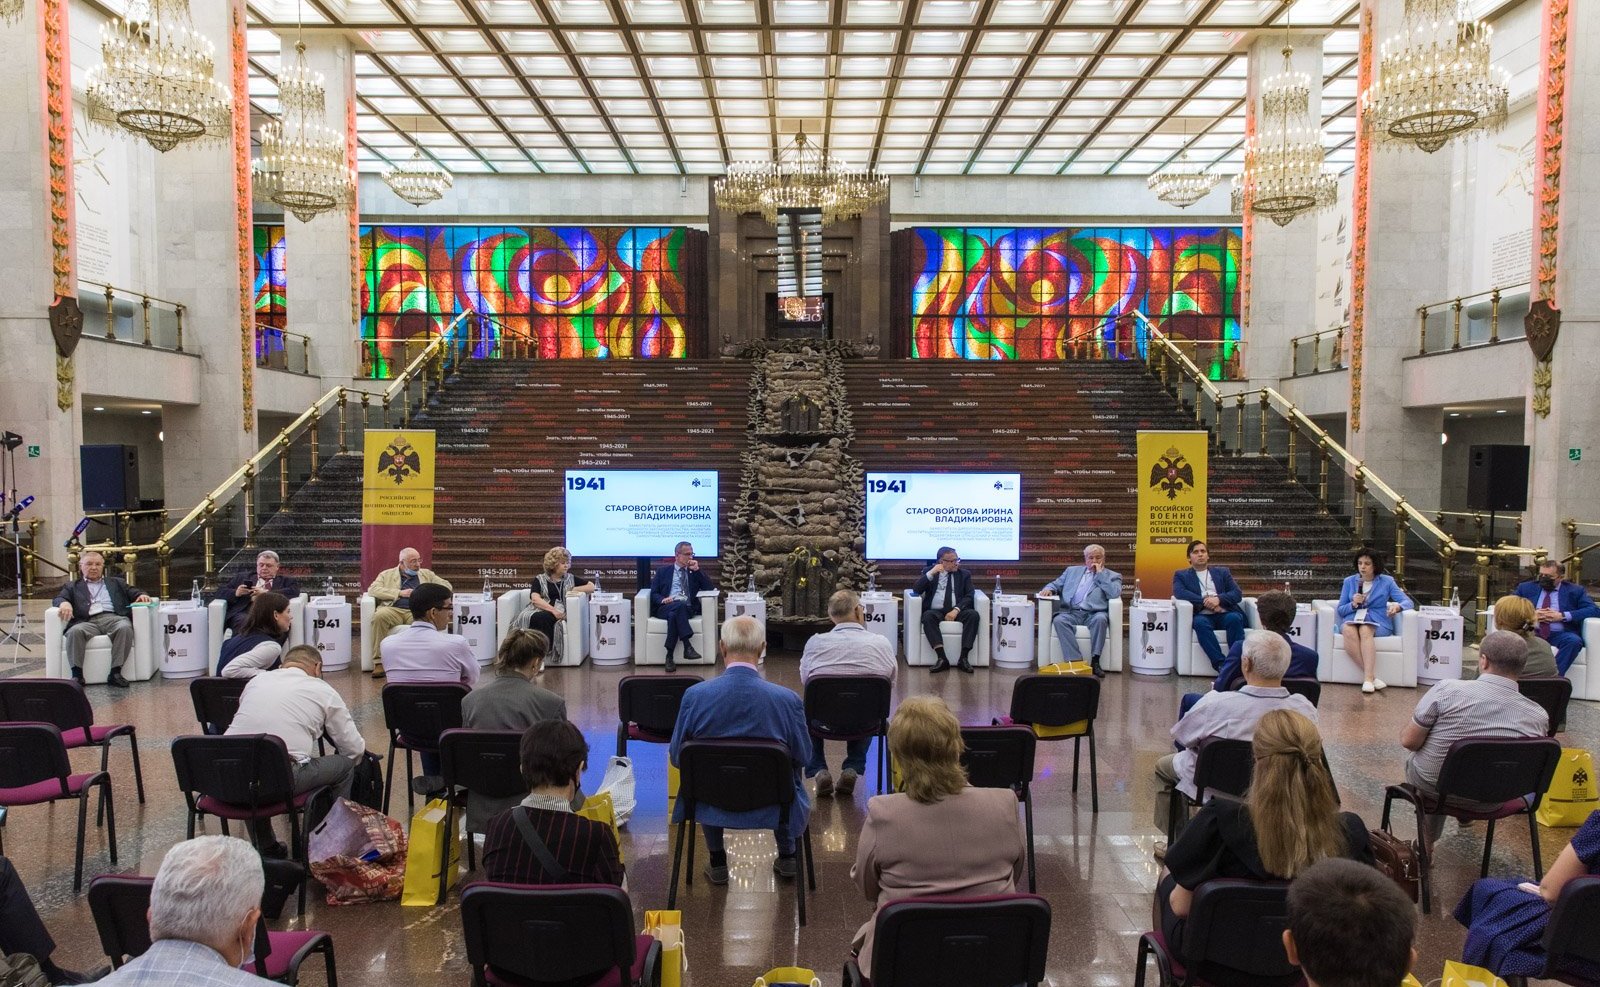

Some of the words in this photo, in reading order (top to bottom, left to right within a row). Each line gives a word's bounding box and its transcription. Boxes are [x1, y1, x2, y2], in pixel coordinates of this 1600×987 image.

[567, 478, 605, 490] 1941
[868, 480, 906, 493] 1941
[605, 504, 678, 512] СТАРОВОЙТОВА
[906, 507, 979, 515] СТАРОВОЙТОВА
[634, 513, 712, 521] ВЛАДИМИРОВНА
[458, 616, 482, 625] 1941
[596, 615, 620, 624] 1941
[864, 614, 886, 622] 1941
[998, 617, 1021, 626] 1941
[314, 619, 340, 628] 1941
[1142, 622, 1168, 631] 1941
[164, 624, 192, 634] 1941
[1288, 627, 1301, 636] 41
[1425, 630, 1455, 641] 1941
